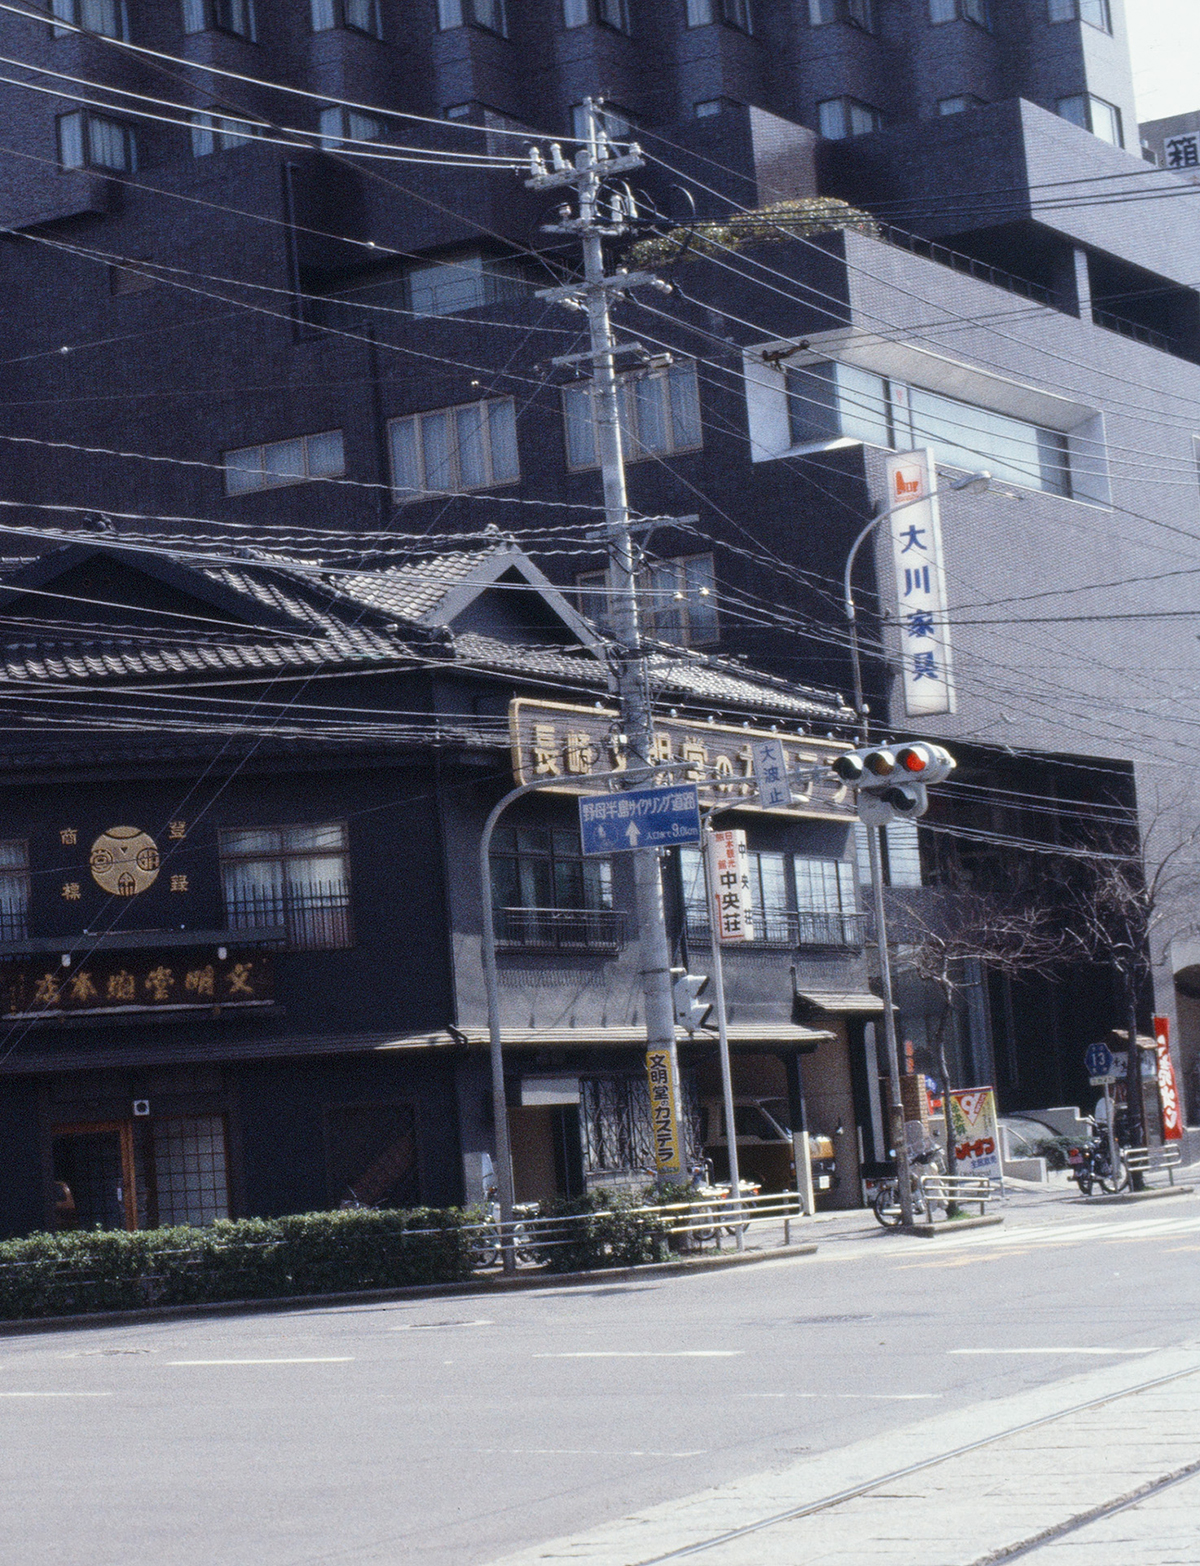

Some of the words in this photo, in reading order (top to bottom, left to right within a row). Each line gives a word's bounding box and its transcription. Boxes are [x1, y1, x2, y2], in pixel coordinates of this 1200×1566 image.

[900, 525, 938, 682] 大川家具
[760, 746, 785, 805] 大波止
[720, 871, 741, 932] 中央荘
[738, 842, 753, 925] 中央荘
[648, 1054, 675, 1163] 文明堂のカステラ
